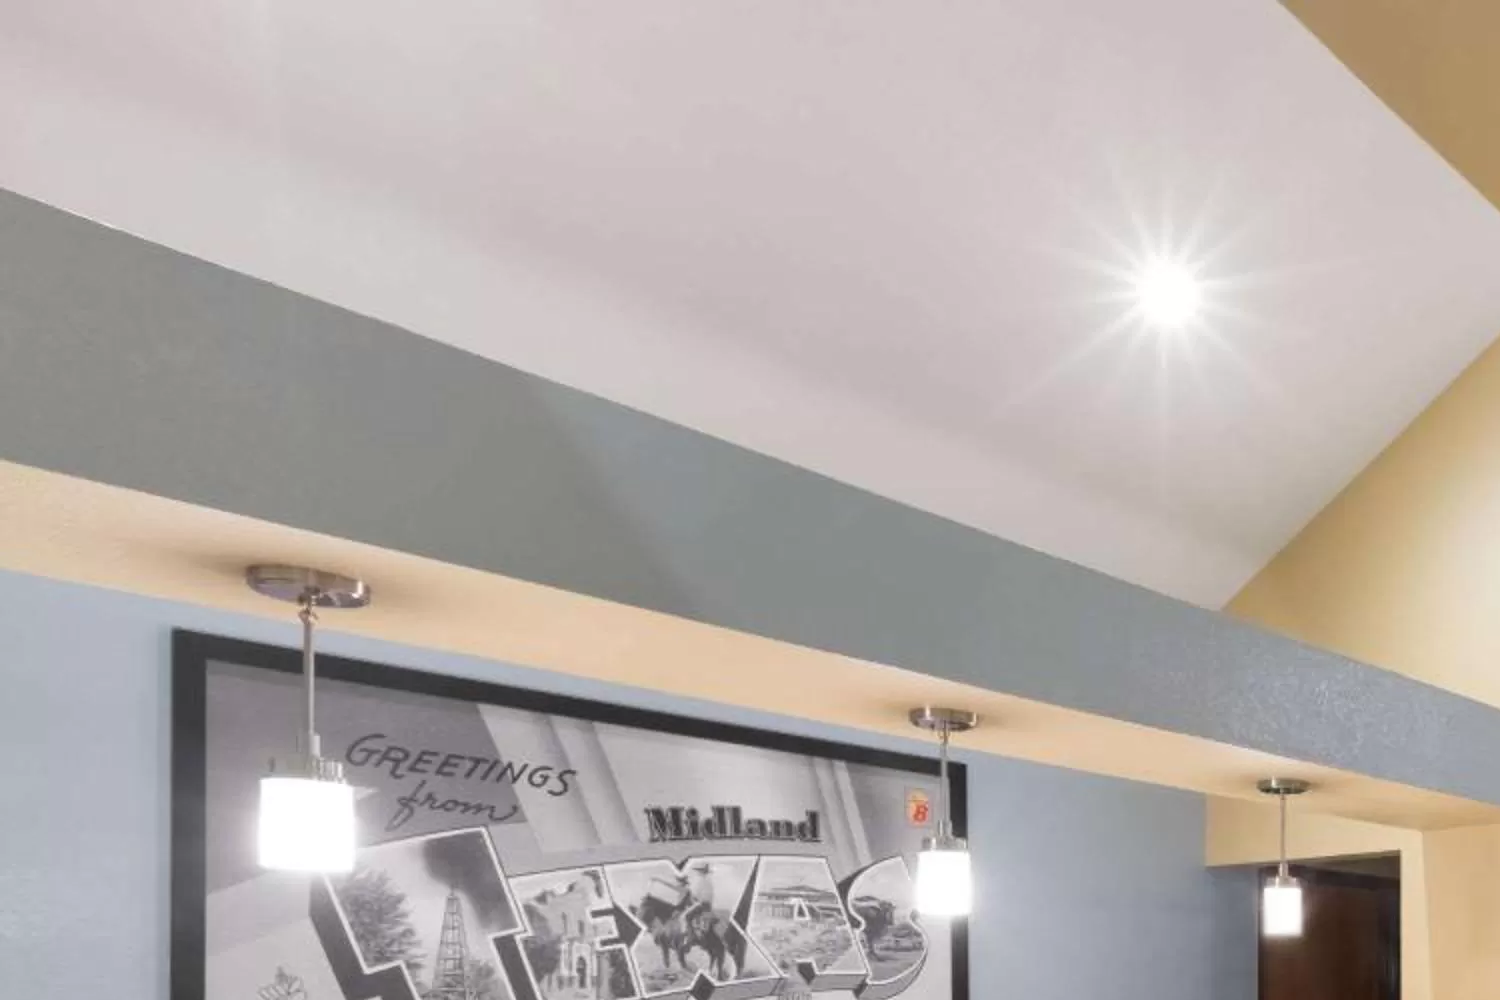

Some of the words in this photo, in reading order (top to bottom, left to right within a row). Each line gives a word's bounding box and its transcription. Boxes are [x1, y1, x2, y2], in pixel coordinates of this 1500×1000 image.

[345, 733, 577, 797] GREETINGS
[384, 779, 519, 832] from
[643, 805, 822, 843] Midland
